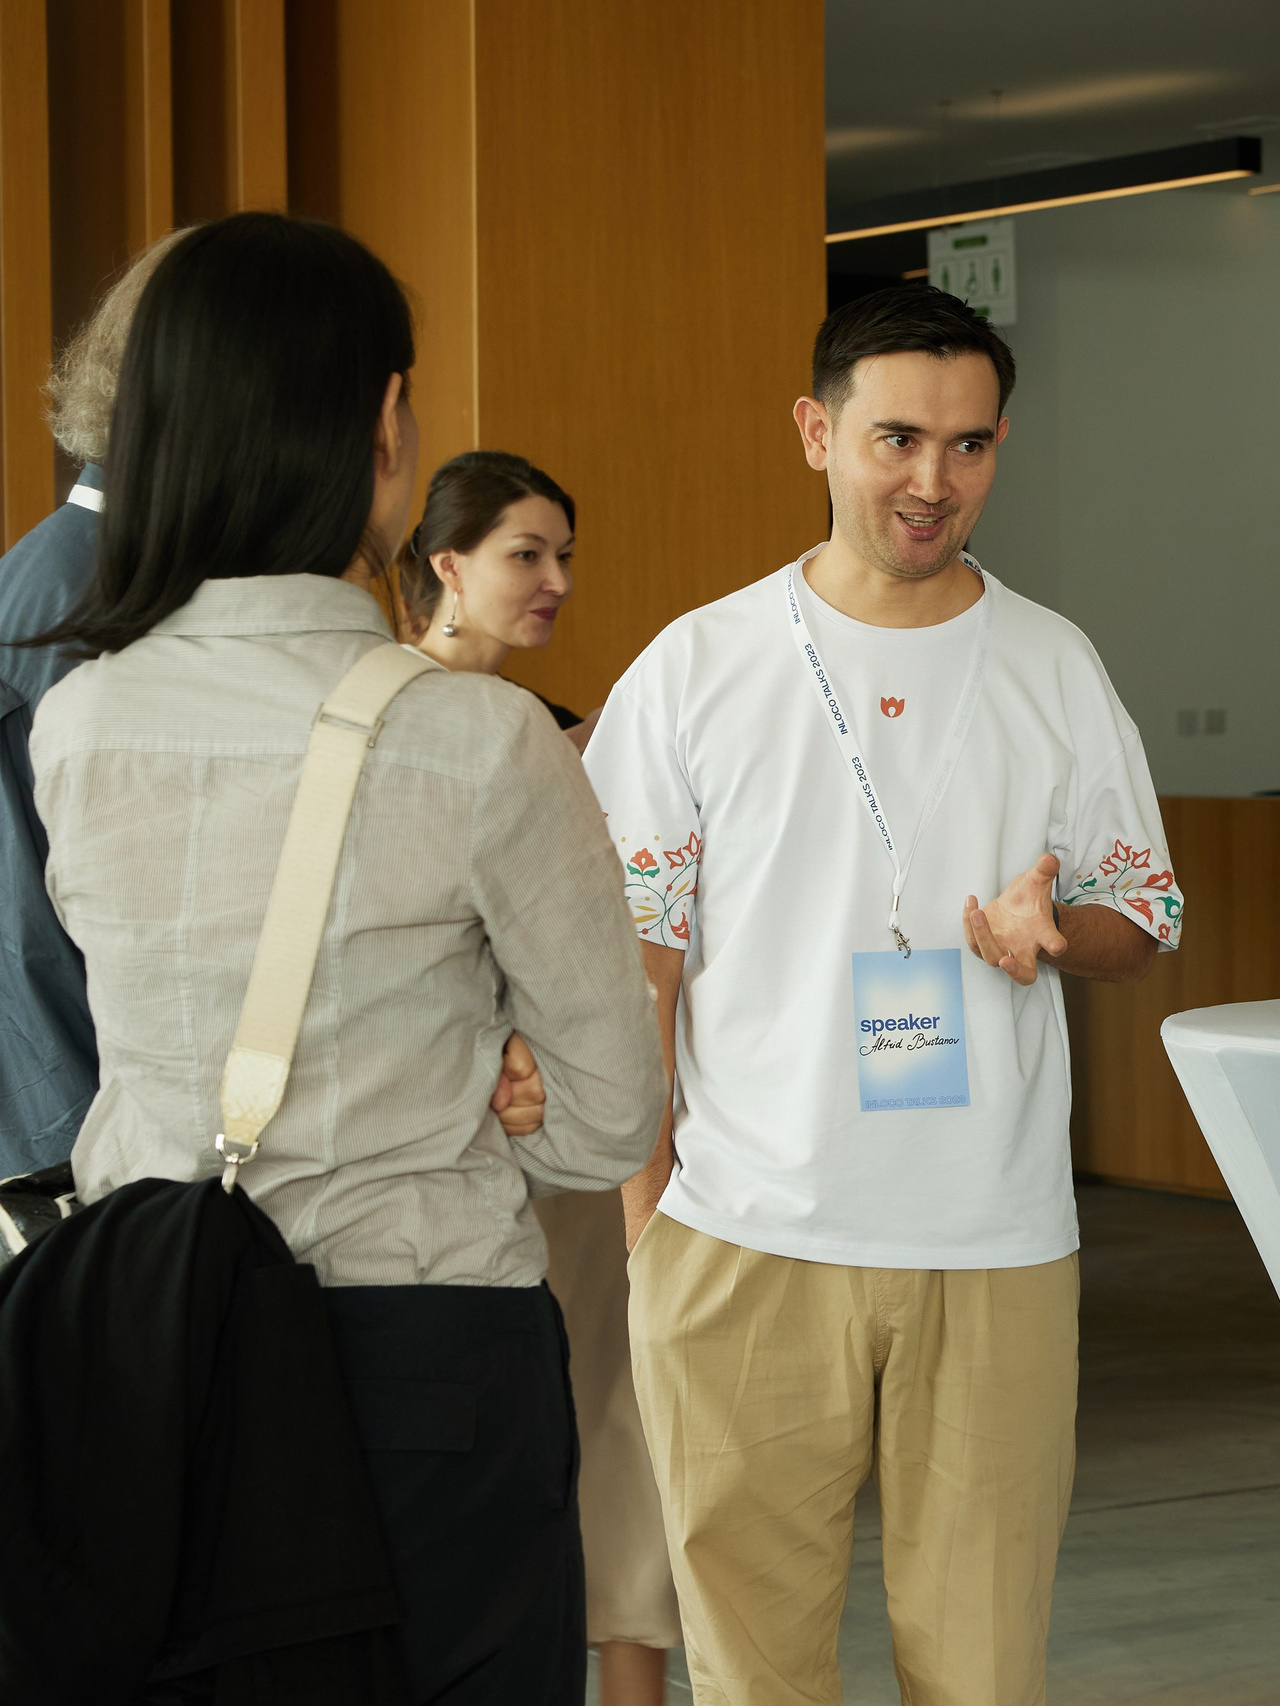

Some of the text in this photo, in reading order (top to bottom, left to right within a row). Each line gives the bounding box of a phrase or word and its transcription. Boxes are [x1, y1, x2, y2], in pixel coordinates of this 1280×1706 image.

[789, 592, 801, 625] INLOCO
[804, 643, 849, 735] INLOCO TALKS 2023
[851, 756, 894, 851] INLOCO TALKS 2023
[860, 1013, 940, 1037] speaker
[907, 1032, 960, 1051] Bustanov
[864, 1094, 967, 1109] INLOCO TALKS 2023
